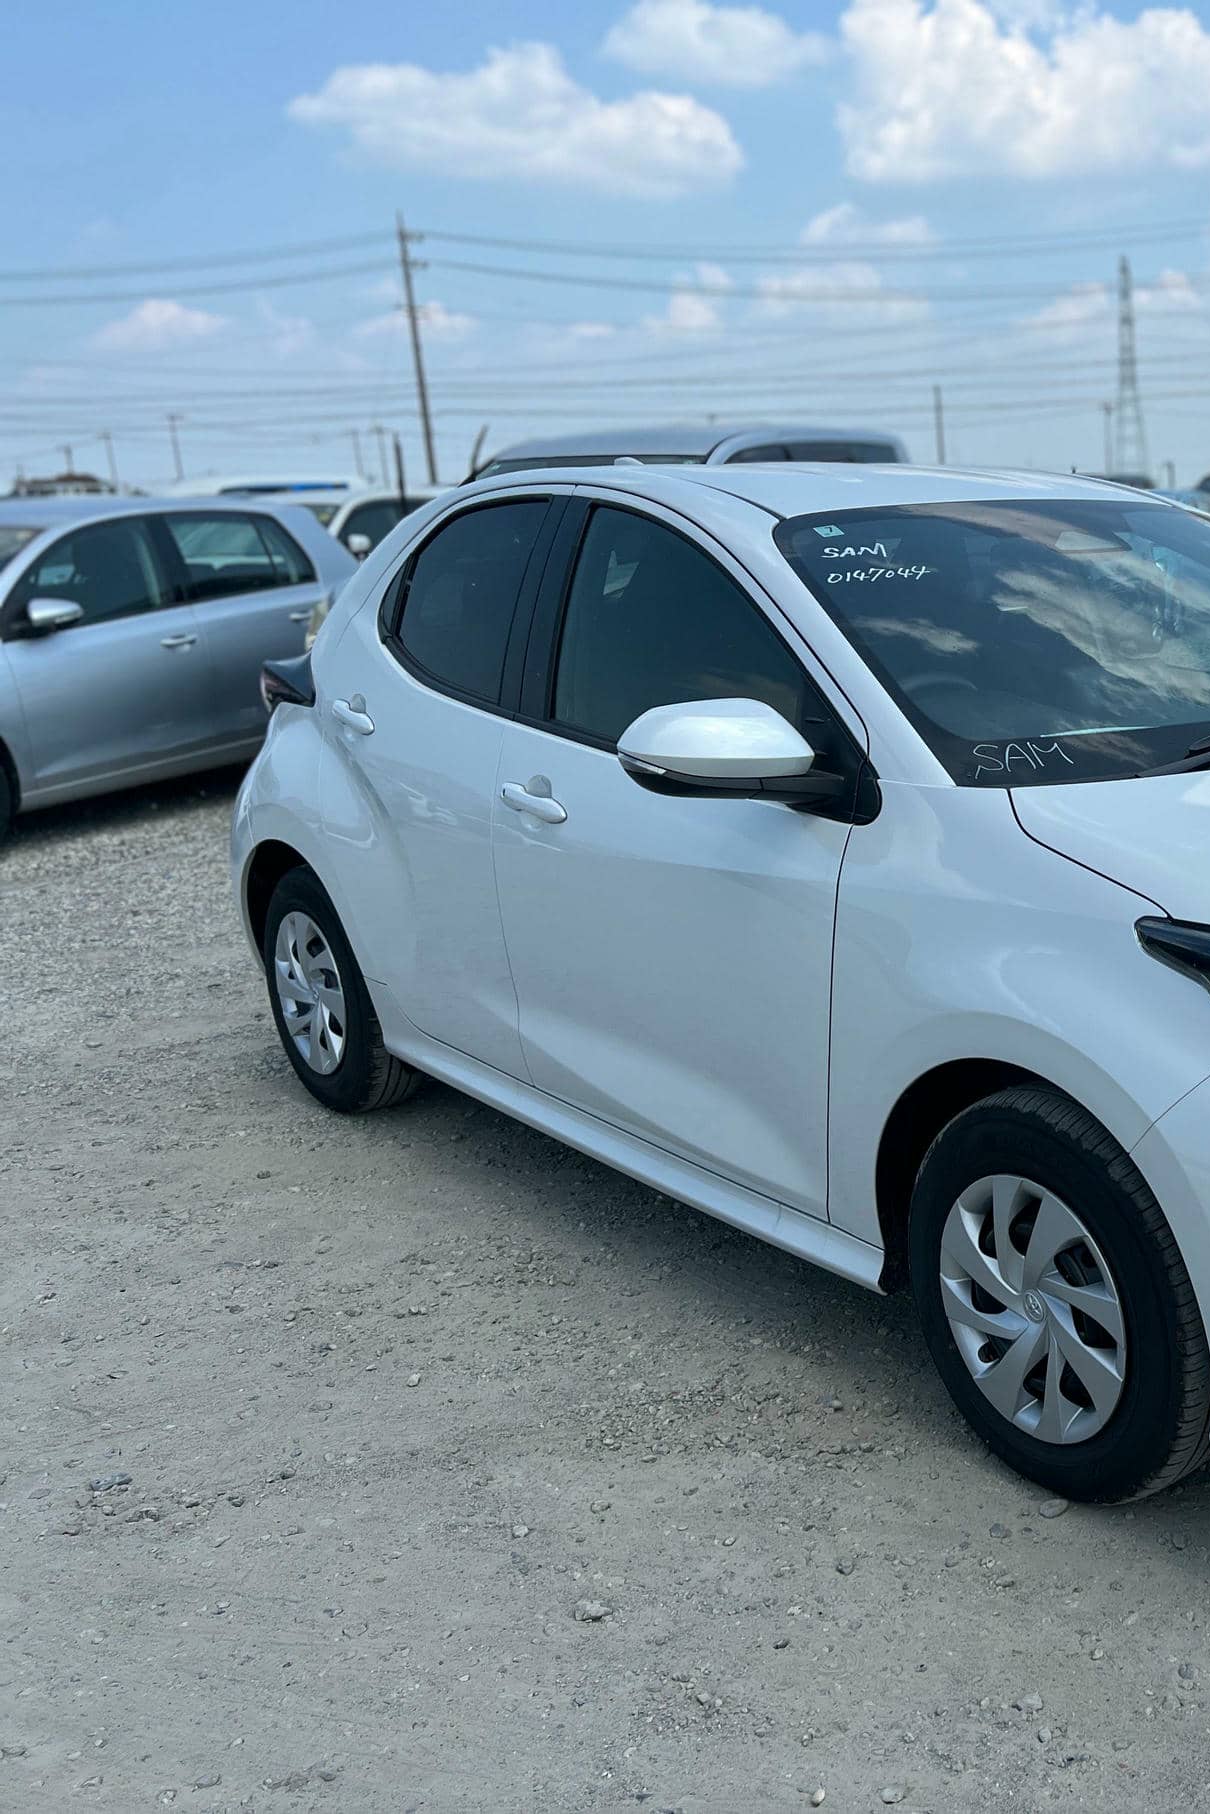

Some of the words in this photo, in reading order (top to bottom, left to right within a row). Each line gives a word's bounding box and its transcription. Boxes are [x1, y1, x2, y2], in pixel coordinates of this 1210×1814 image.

[820, 542, 887, 558] SAM
[826, 565, 931, 584] 0147044
[972, 741, 1075, 780] SAM
